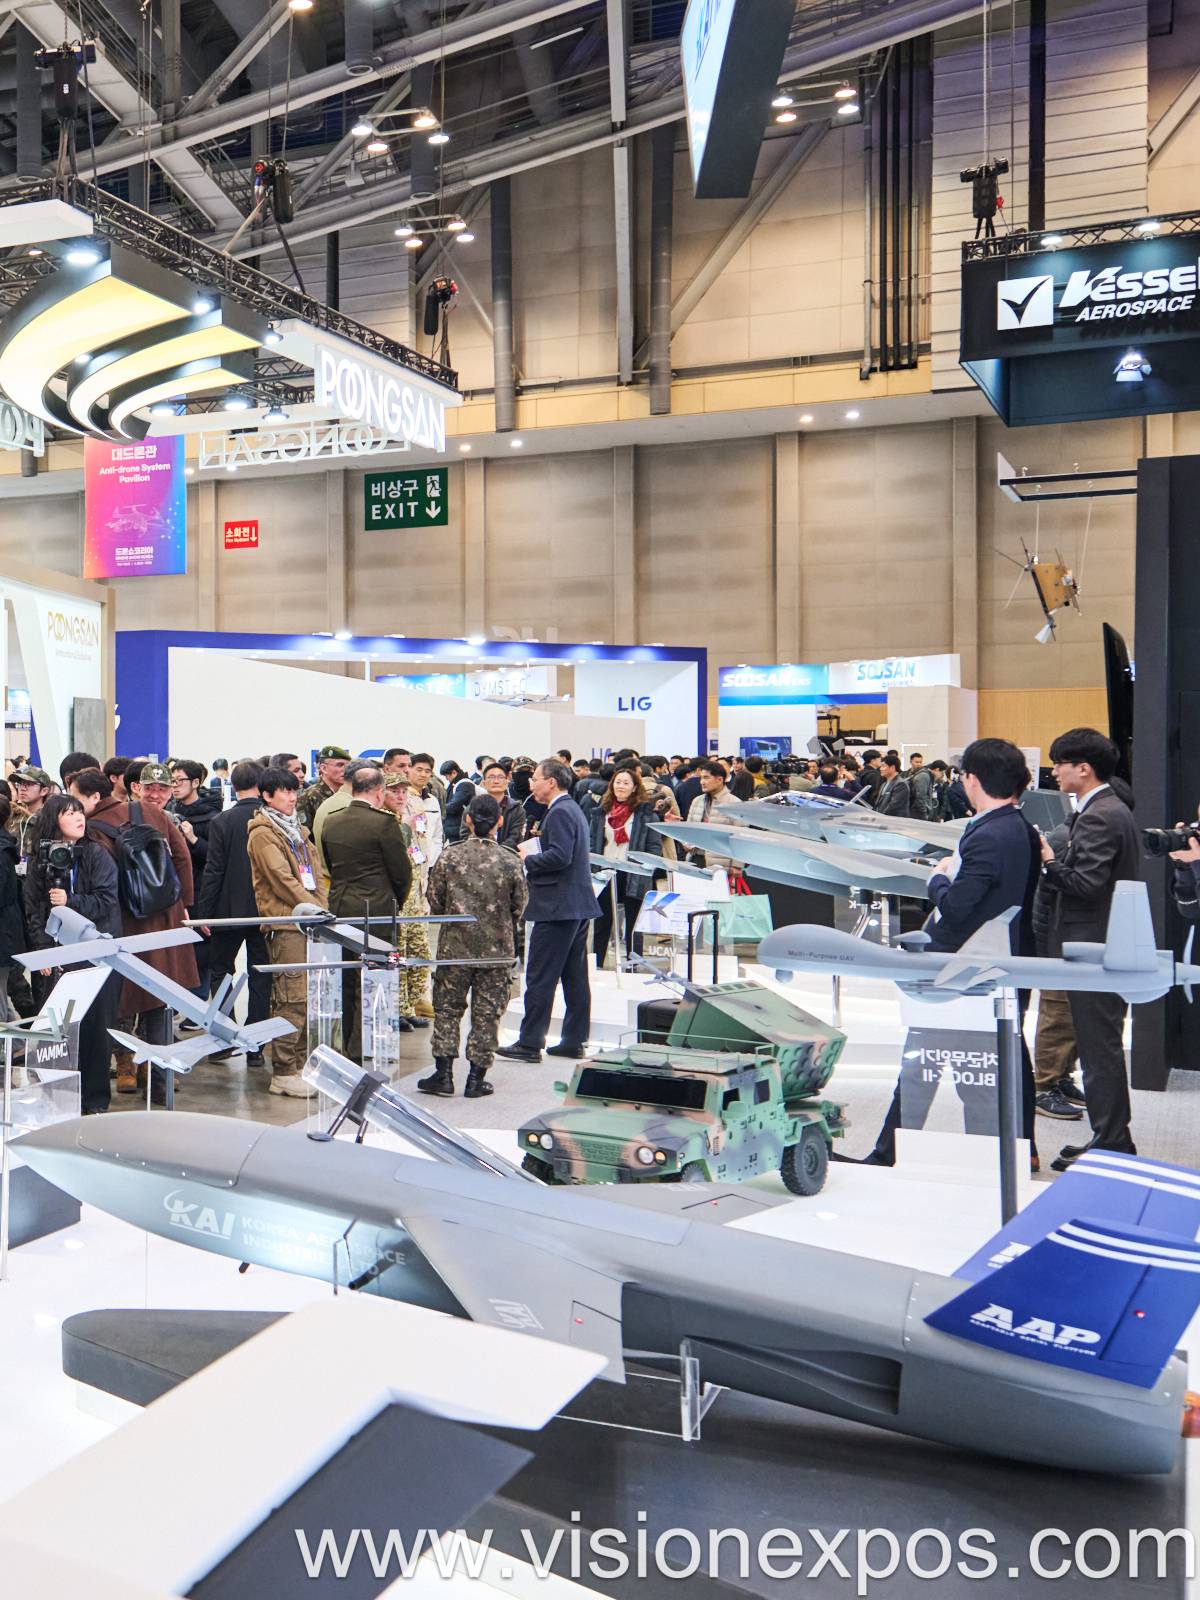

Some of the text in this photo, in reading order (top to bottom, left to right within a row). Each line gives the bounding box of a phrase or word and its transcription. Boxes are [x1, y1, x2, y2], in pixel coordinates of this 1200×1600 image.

[1059, 256, 1200, 307] VESSE
[1075, 295, 1196, 323] AEROSPACE
[320, 350, 446, 454] POONGSAN
[99, 463, 171, 475] Anti-drone System
[119, 474, 151, 484] Pavilion
[371, 479, 419, 500] 비상구
[371, 501, 419, 520] EXIT
[225, 526, 250, 539] 소화전
[47, 611, 99, 648] POONGSAN
[618, 696, 652, 712] LIG
[164, 1191, 236, 1237] KAI
[970, 1302, 1102, 1346] AAP
